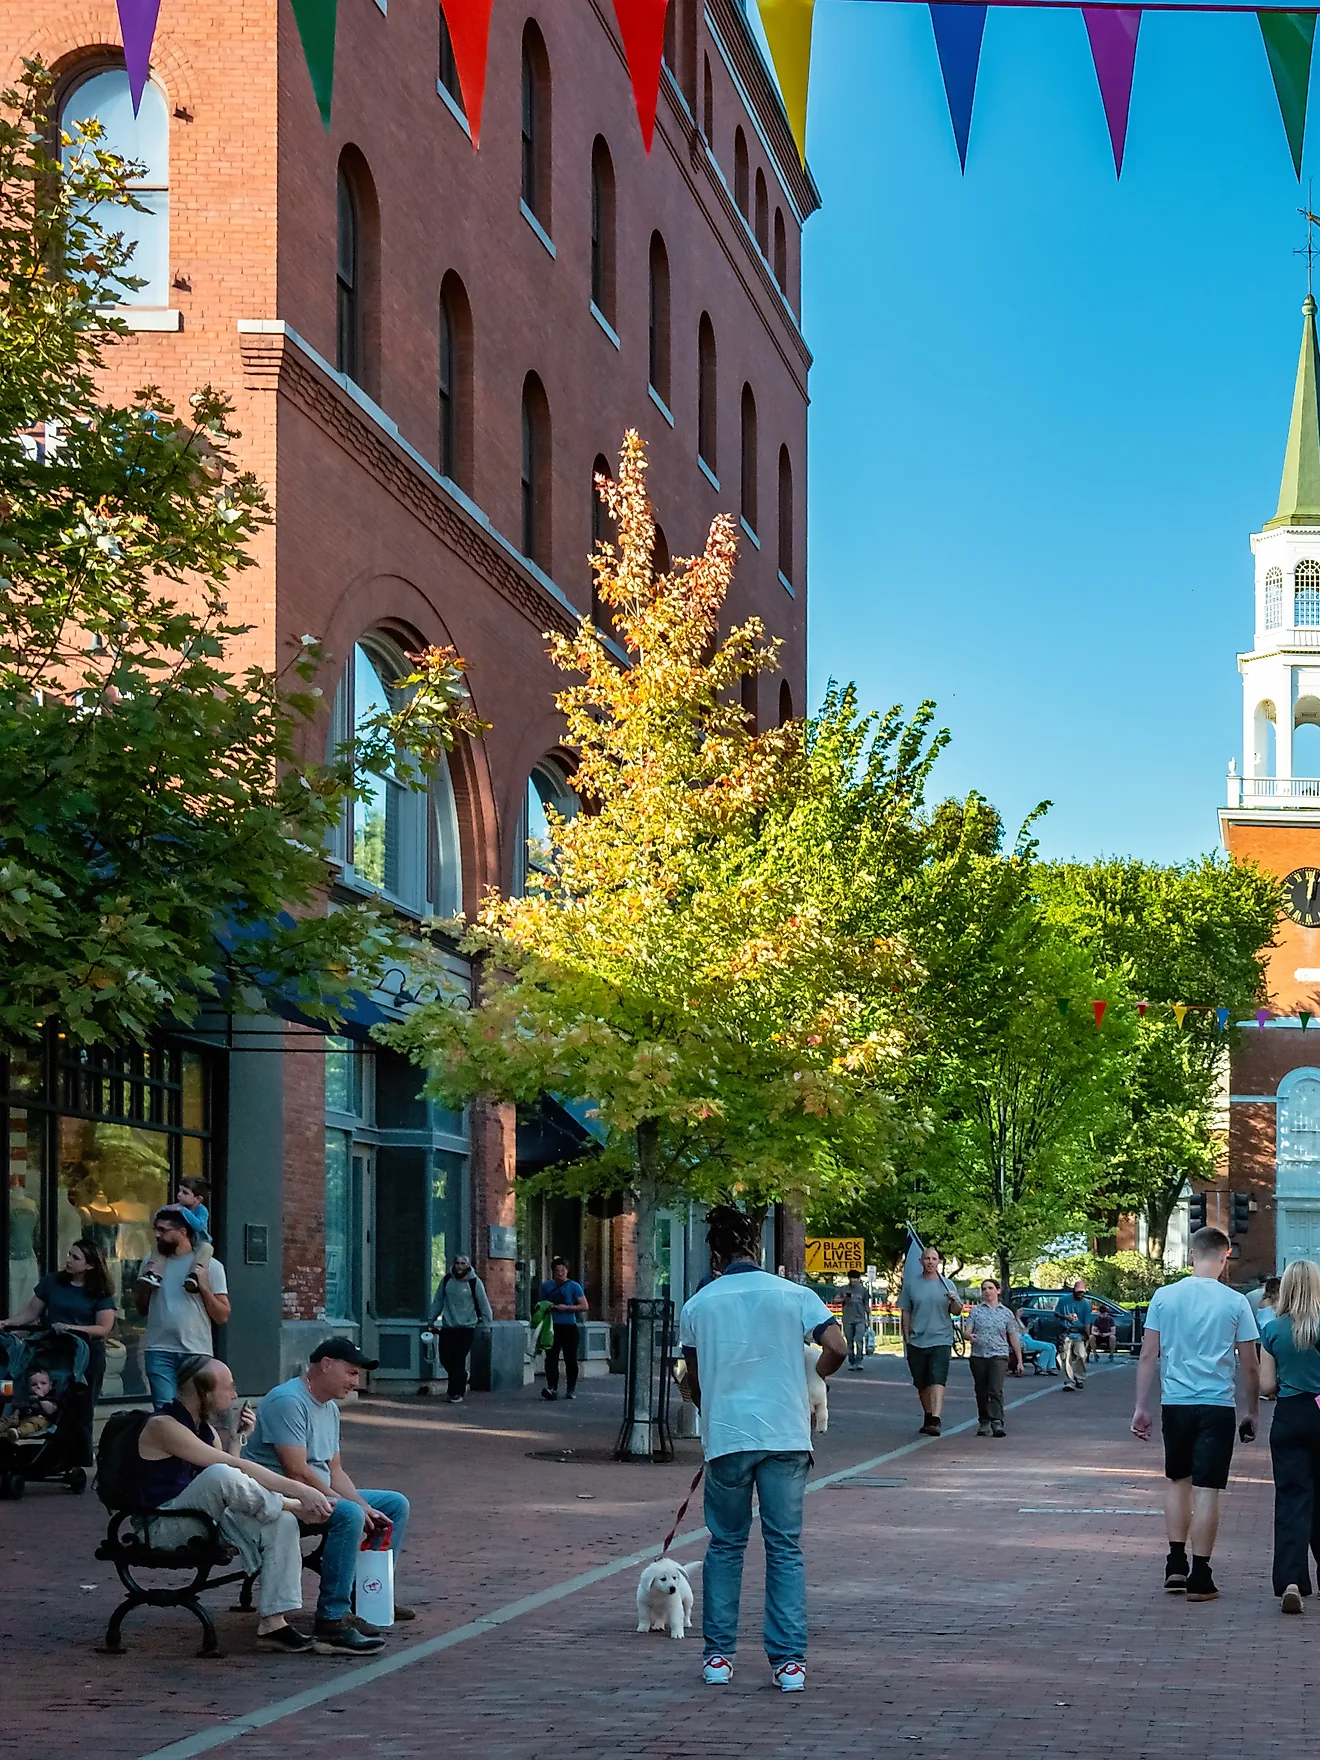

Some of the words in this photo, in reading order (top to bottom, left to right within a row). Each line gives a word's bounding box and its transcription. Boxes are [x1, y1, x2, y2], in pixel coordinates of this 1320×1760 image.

[823, 1241, 861, 1250] BLACK
[823, 1250, 862, 1261] LIVES
[823, 1261, 862, 1269] MATTER
